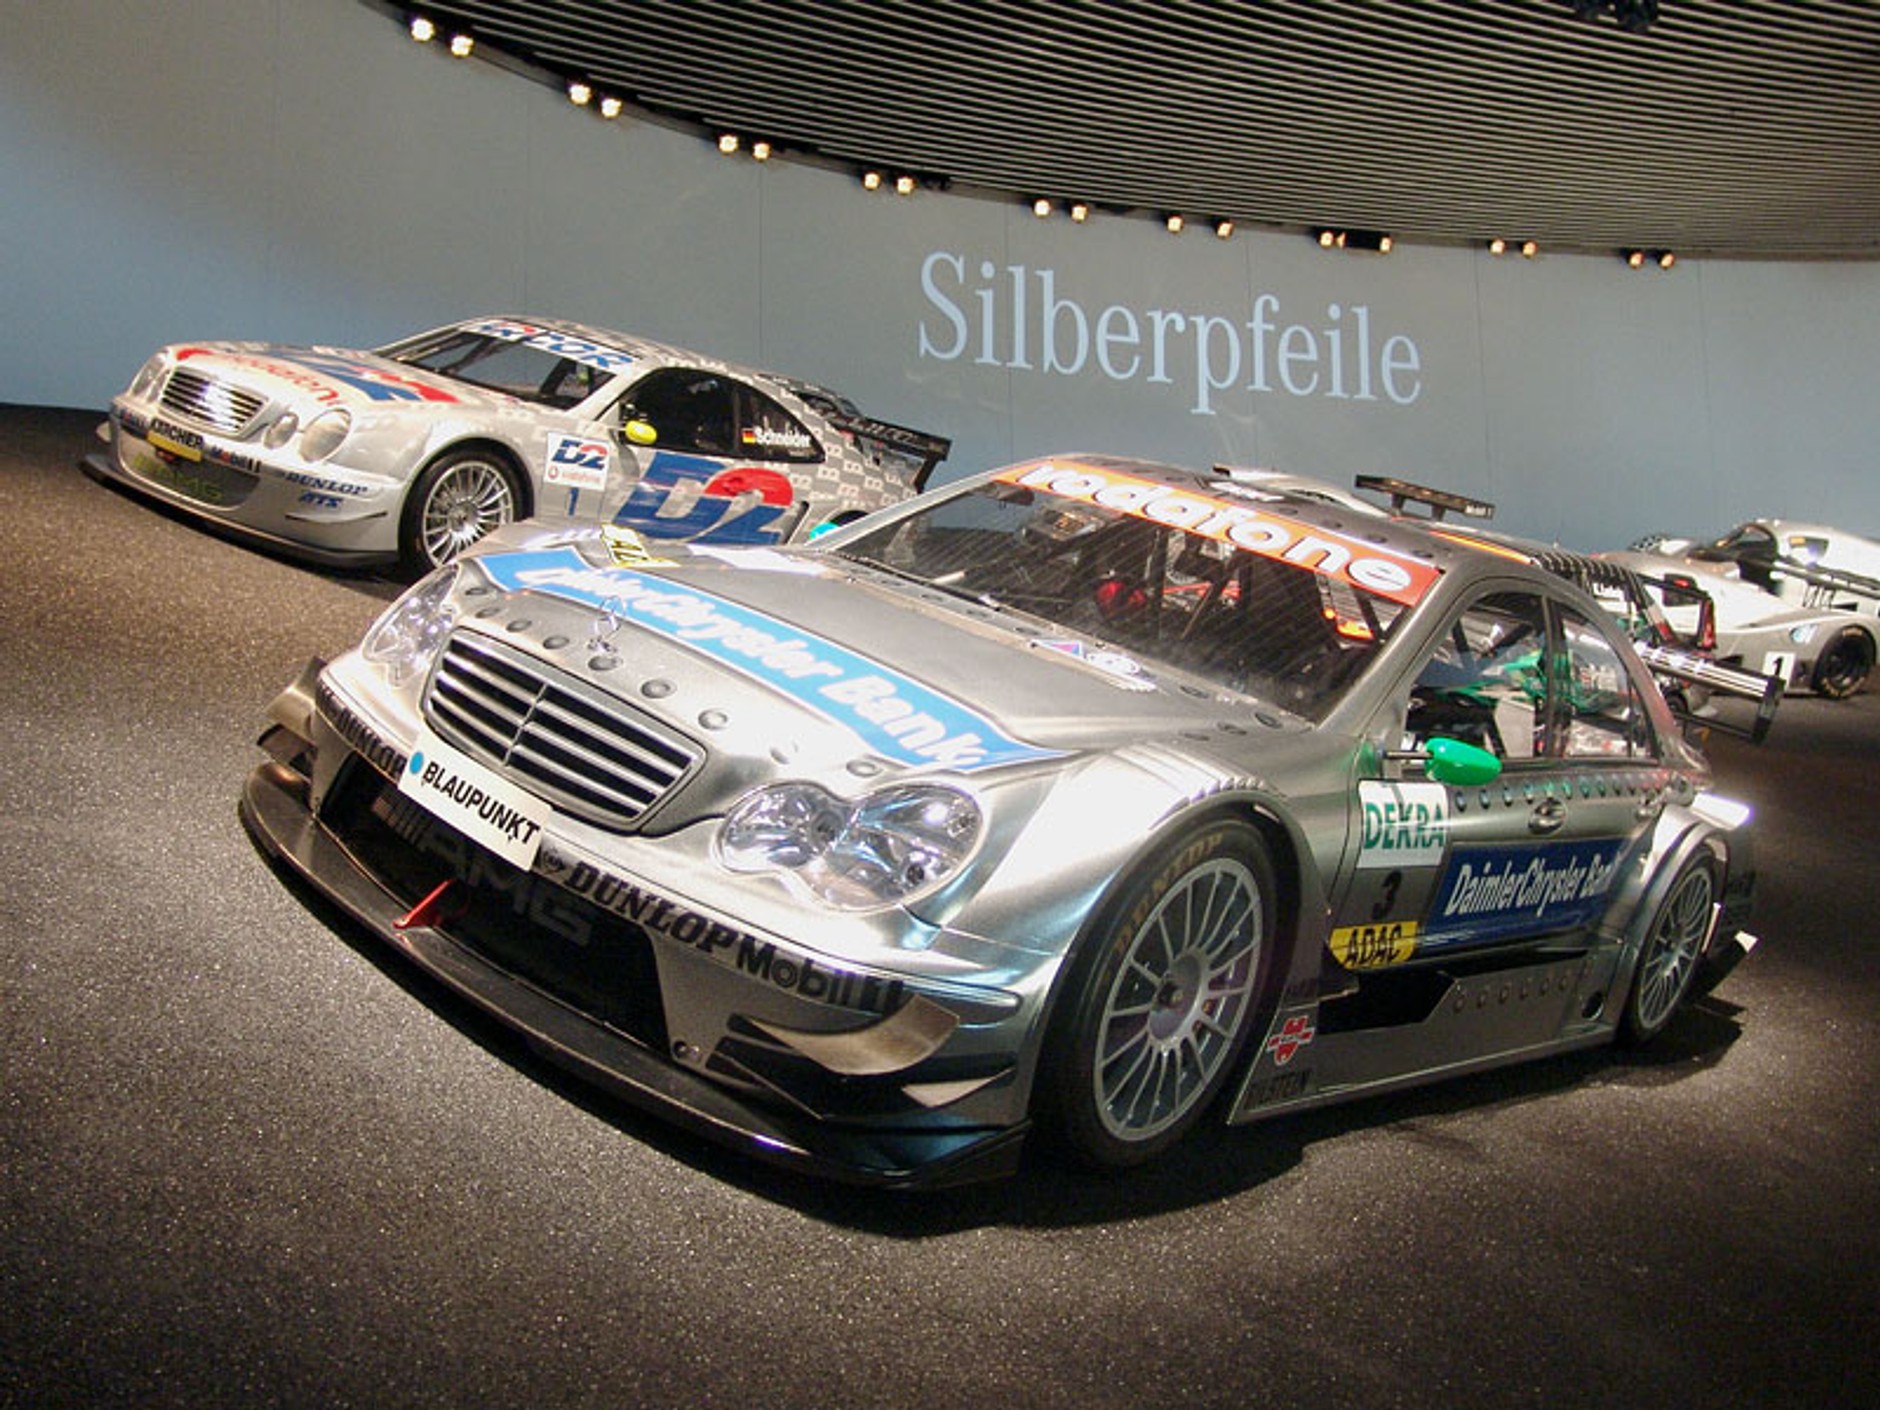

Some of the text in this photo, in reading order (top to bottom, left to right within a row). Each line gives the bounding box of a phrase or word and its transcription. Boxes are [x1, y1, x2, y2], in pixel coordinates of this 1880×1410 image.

[918, 251, 1422, 415] Silberpfeile
[286, 472, 368, 495] DUNLOP
[552, 439, 608, 471] D2
[567, 487, 580, 516] 1
[612, 451, 794, 545] D2
[1017, 464, 1414, 592] vodafone
[1771, 657, 1784, 678] 1
[817, 674, 988, 767] Bank
[422, 762, 541, 844] BLAUPUNKT
[1364, 802, 1446, 851] DEKRA
[1371, 871, 1403, 920] 3
[1443, 853, 1585, 918] DaimlerChrysler
[563, 860, 738, 953] DUNLOP
[735, 934, 857, 1004] Mobil
[1342, 925, 1402, 966] ADAC
